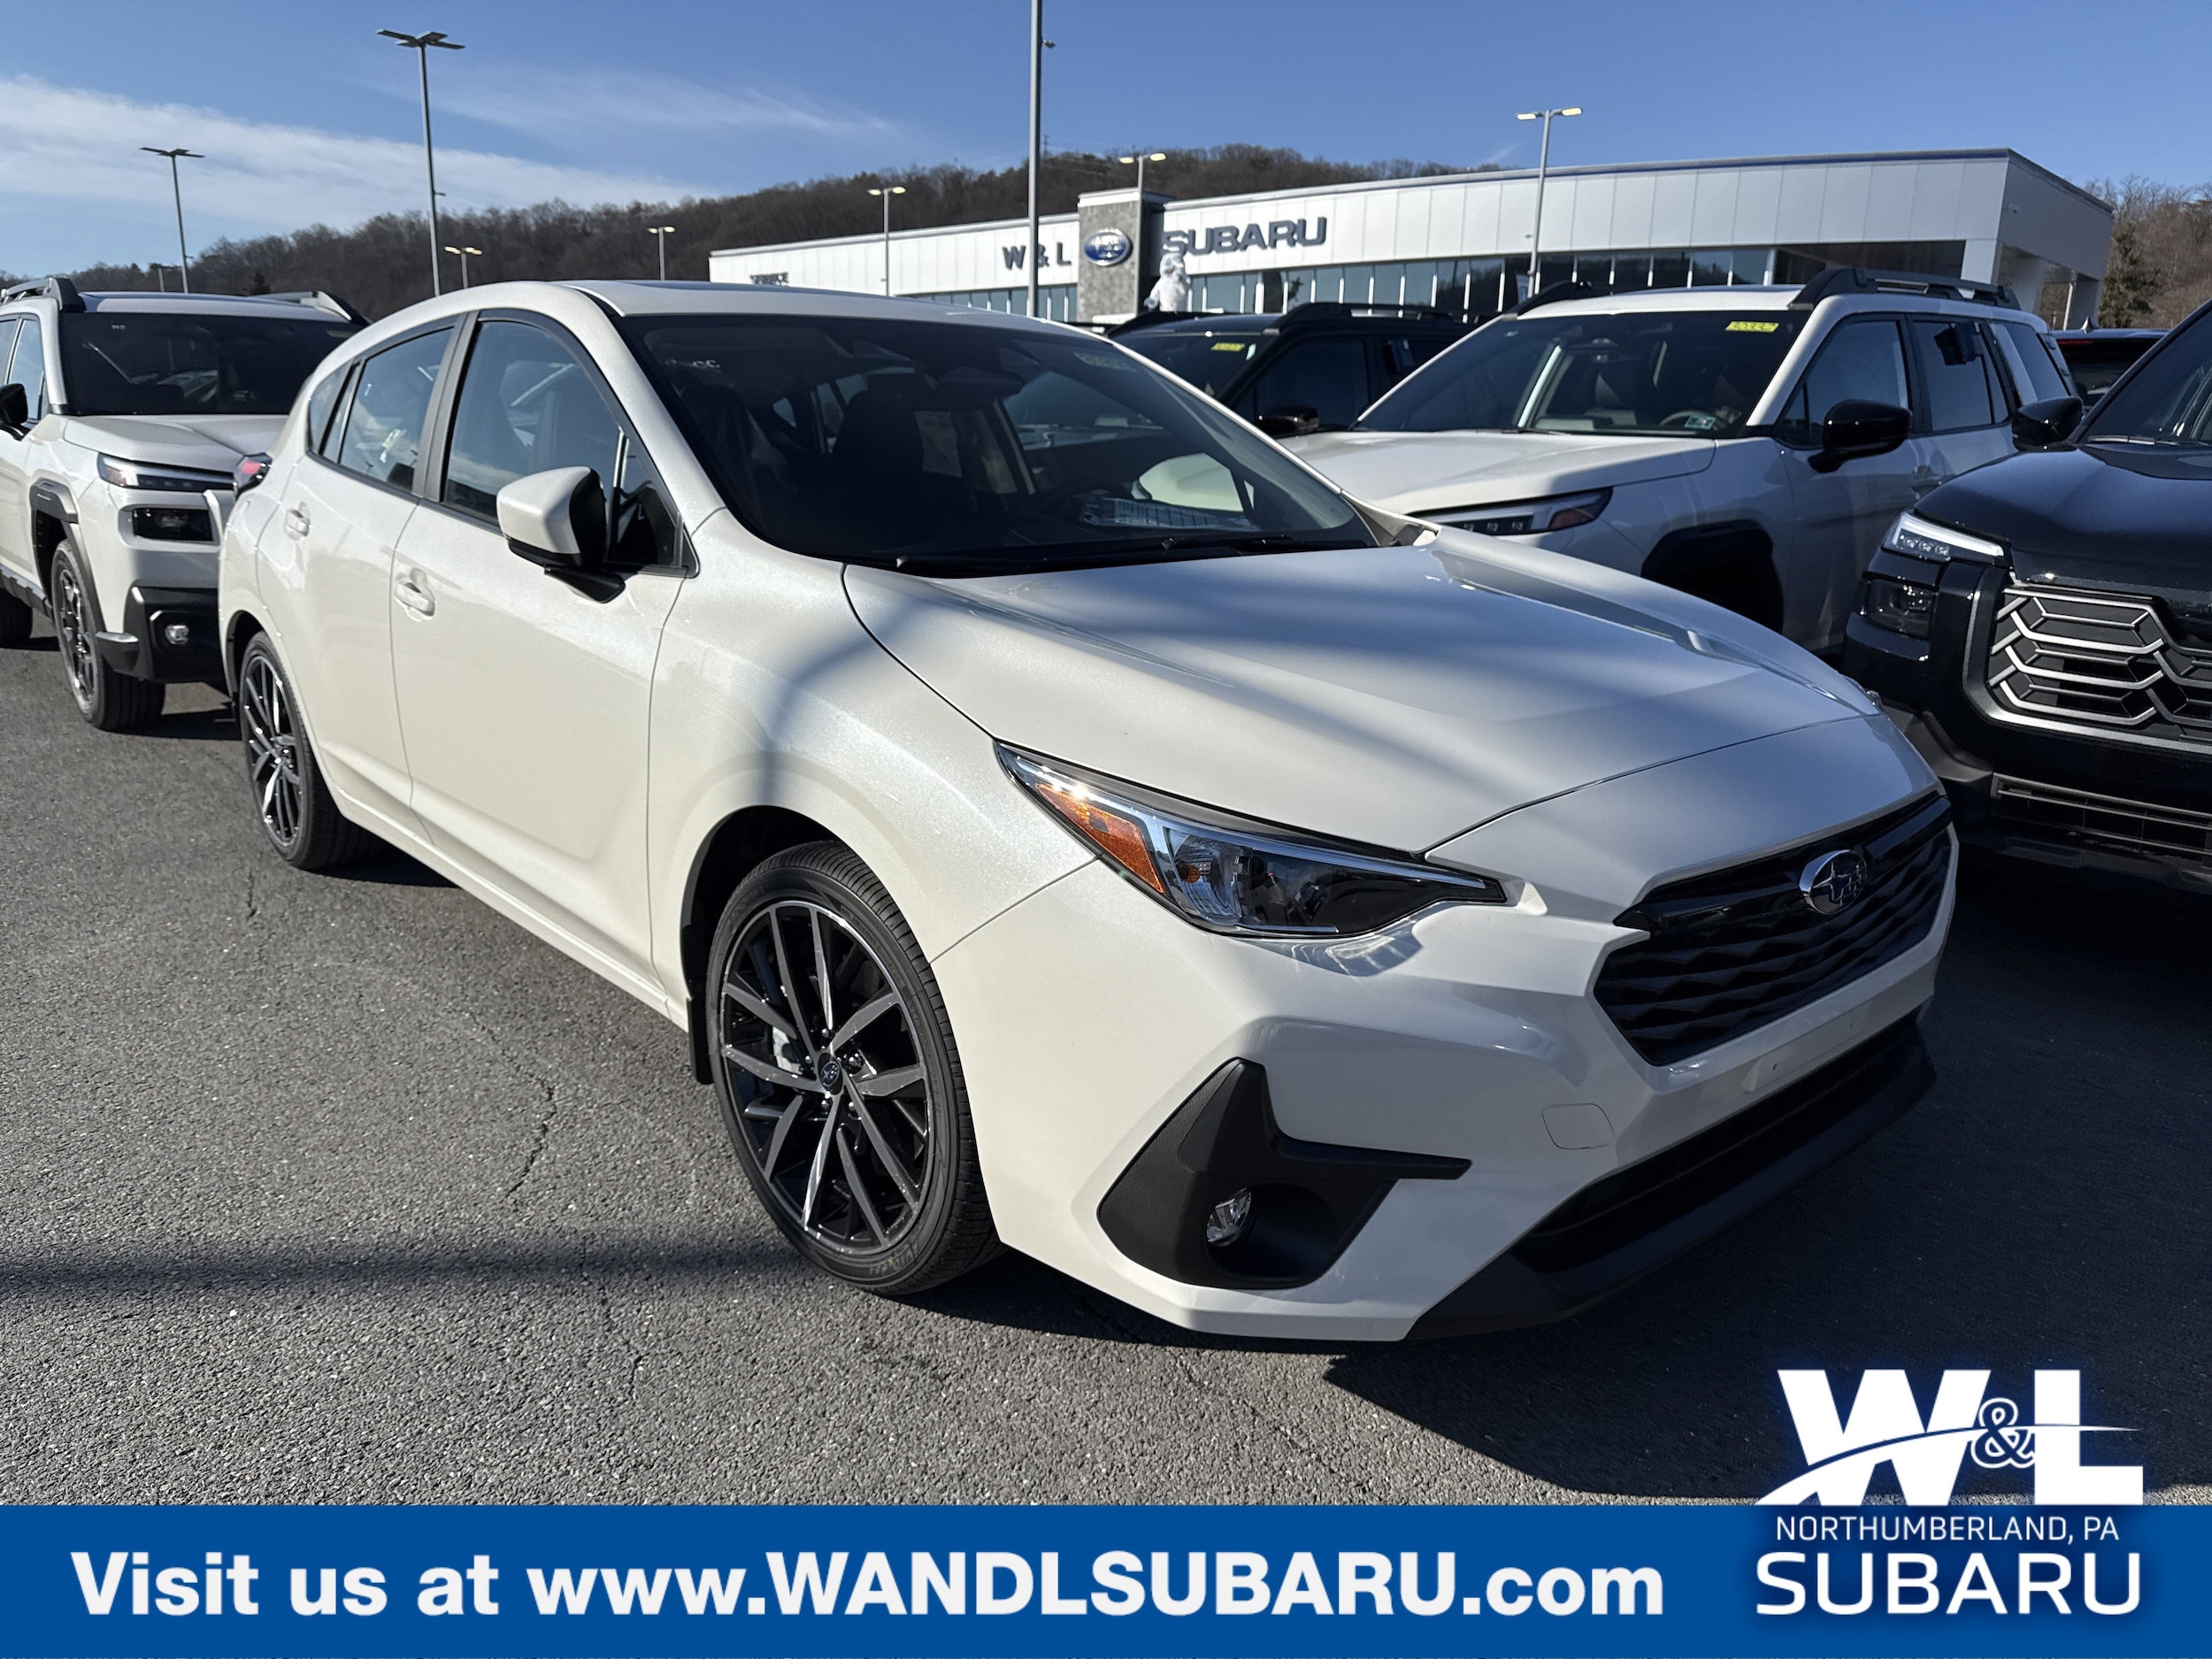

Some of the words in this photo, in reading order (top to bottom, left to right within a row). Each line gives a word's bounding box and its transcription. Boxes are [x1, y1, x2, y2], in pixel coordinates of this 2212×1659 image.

[1162, 217, 1327, 255] SUBARU
[1002, 245, 1026, 271] W
[1056, 242, 1072, 266] L
